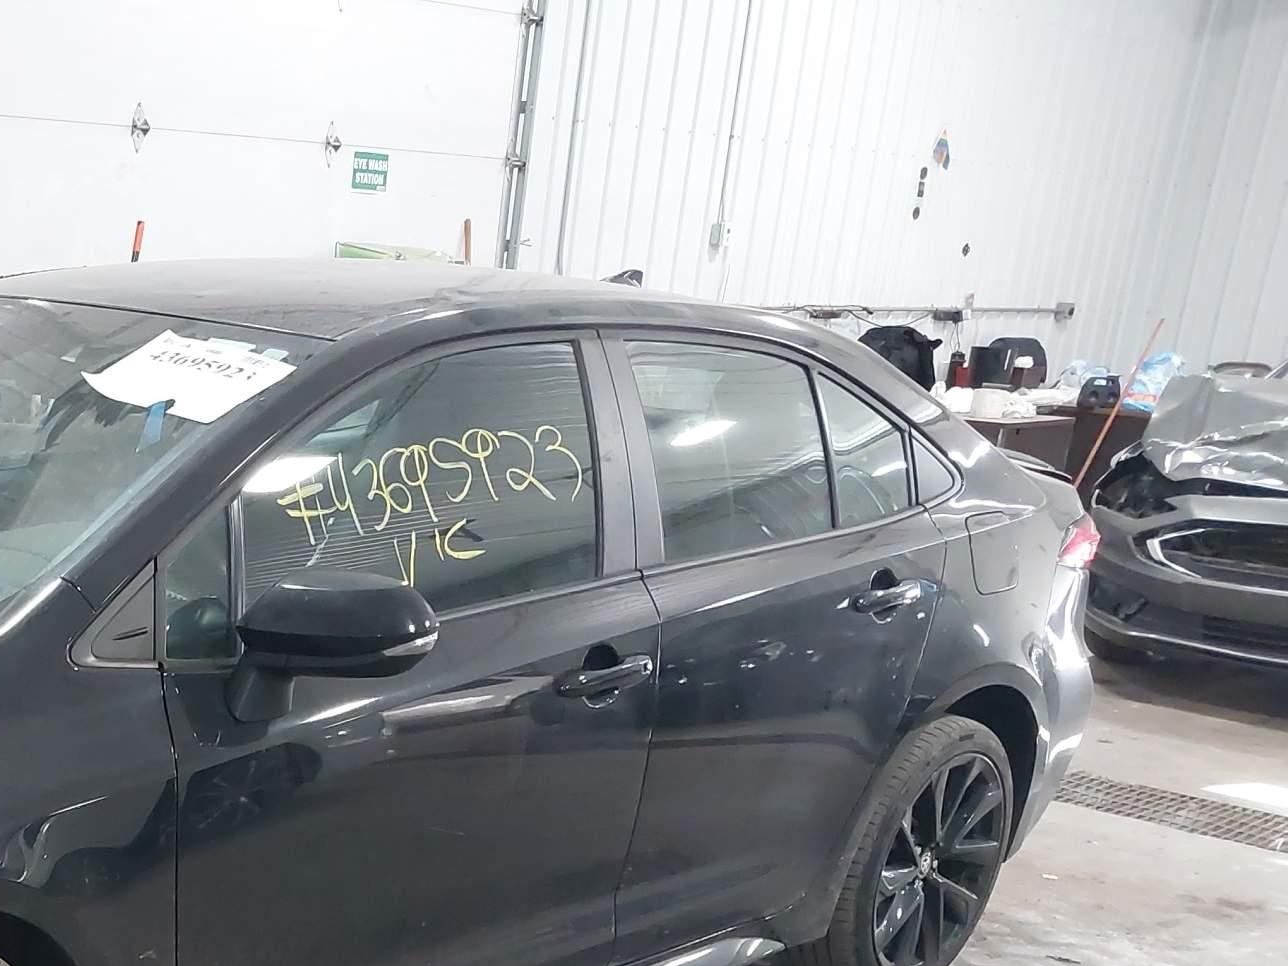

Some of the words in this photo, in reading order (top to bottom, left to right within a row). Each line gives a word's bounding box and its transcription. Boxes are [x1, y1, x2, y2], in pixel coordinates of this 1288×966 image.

[353, 157, 368, 170] EYE
[368, 159, 389, 171] WASH
[354, 172, 386, 185] STATION
